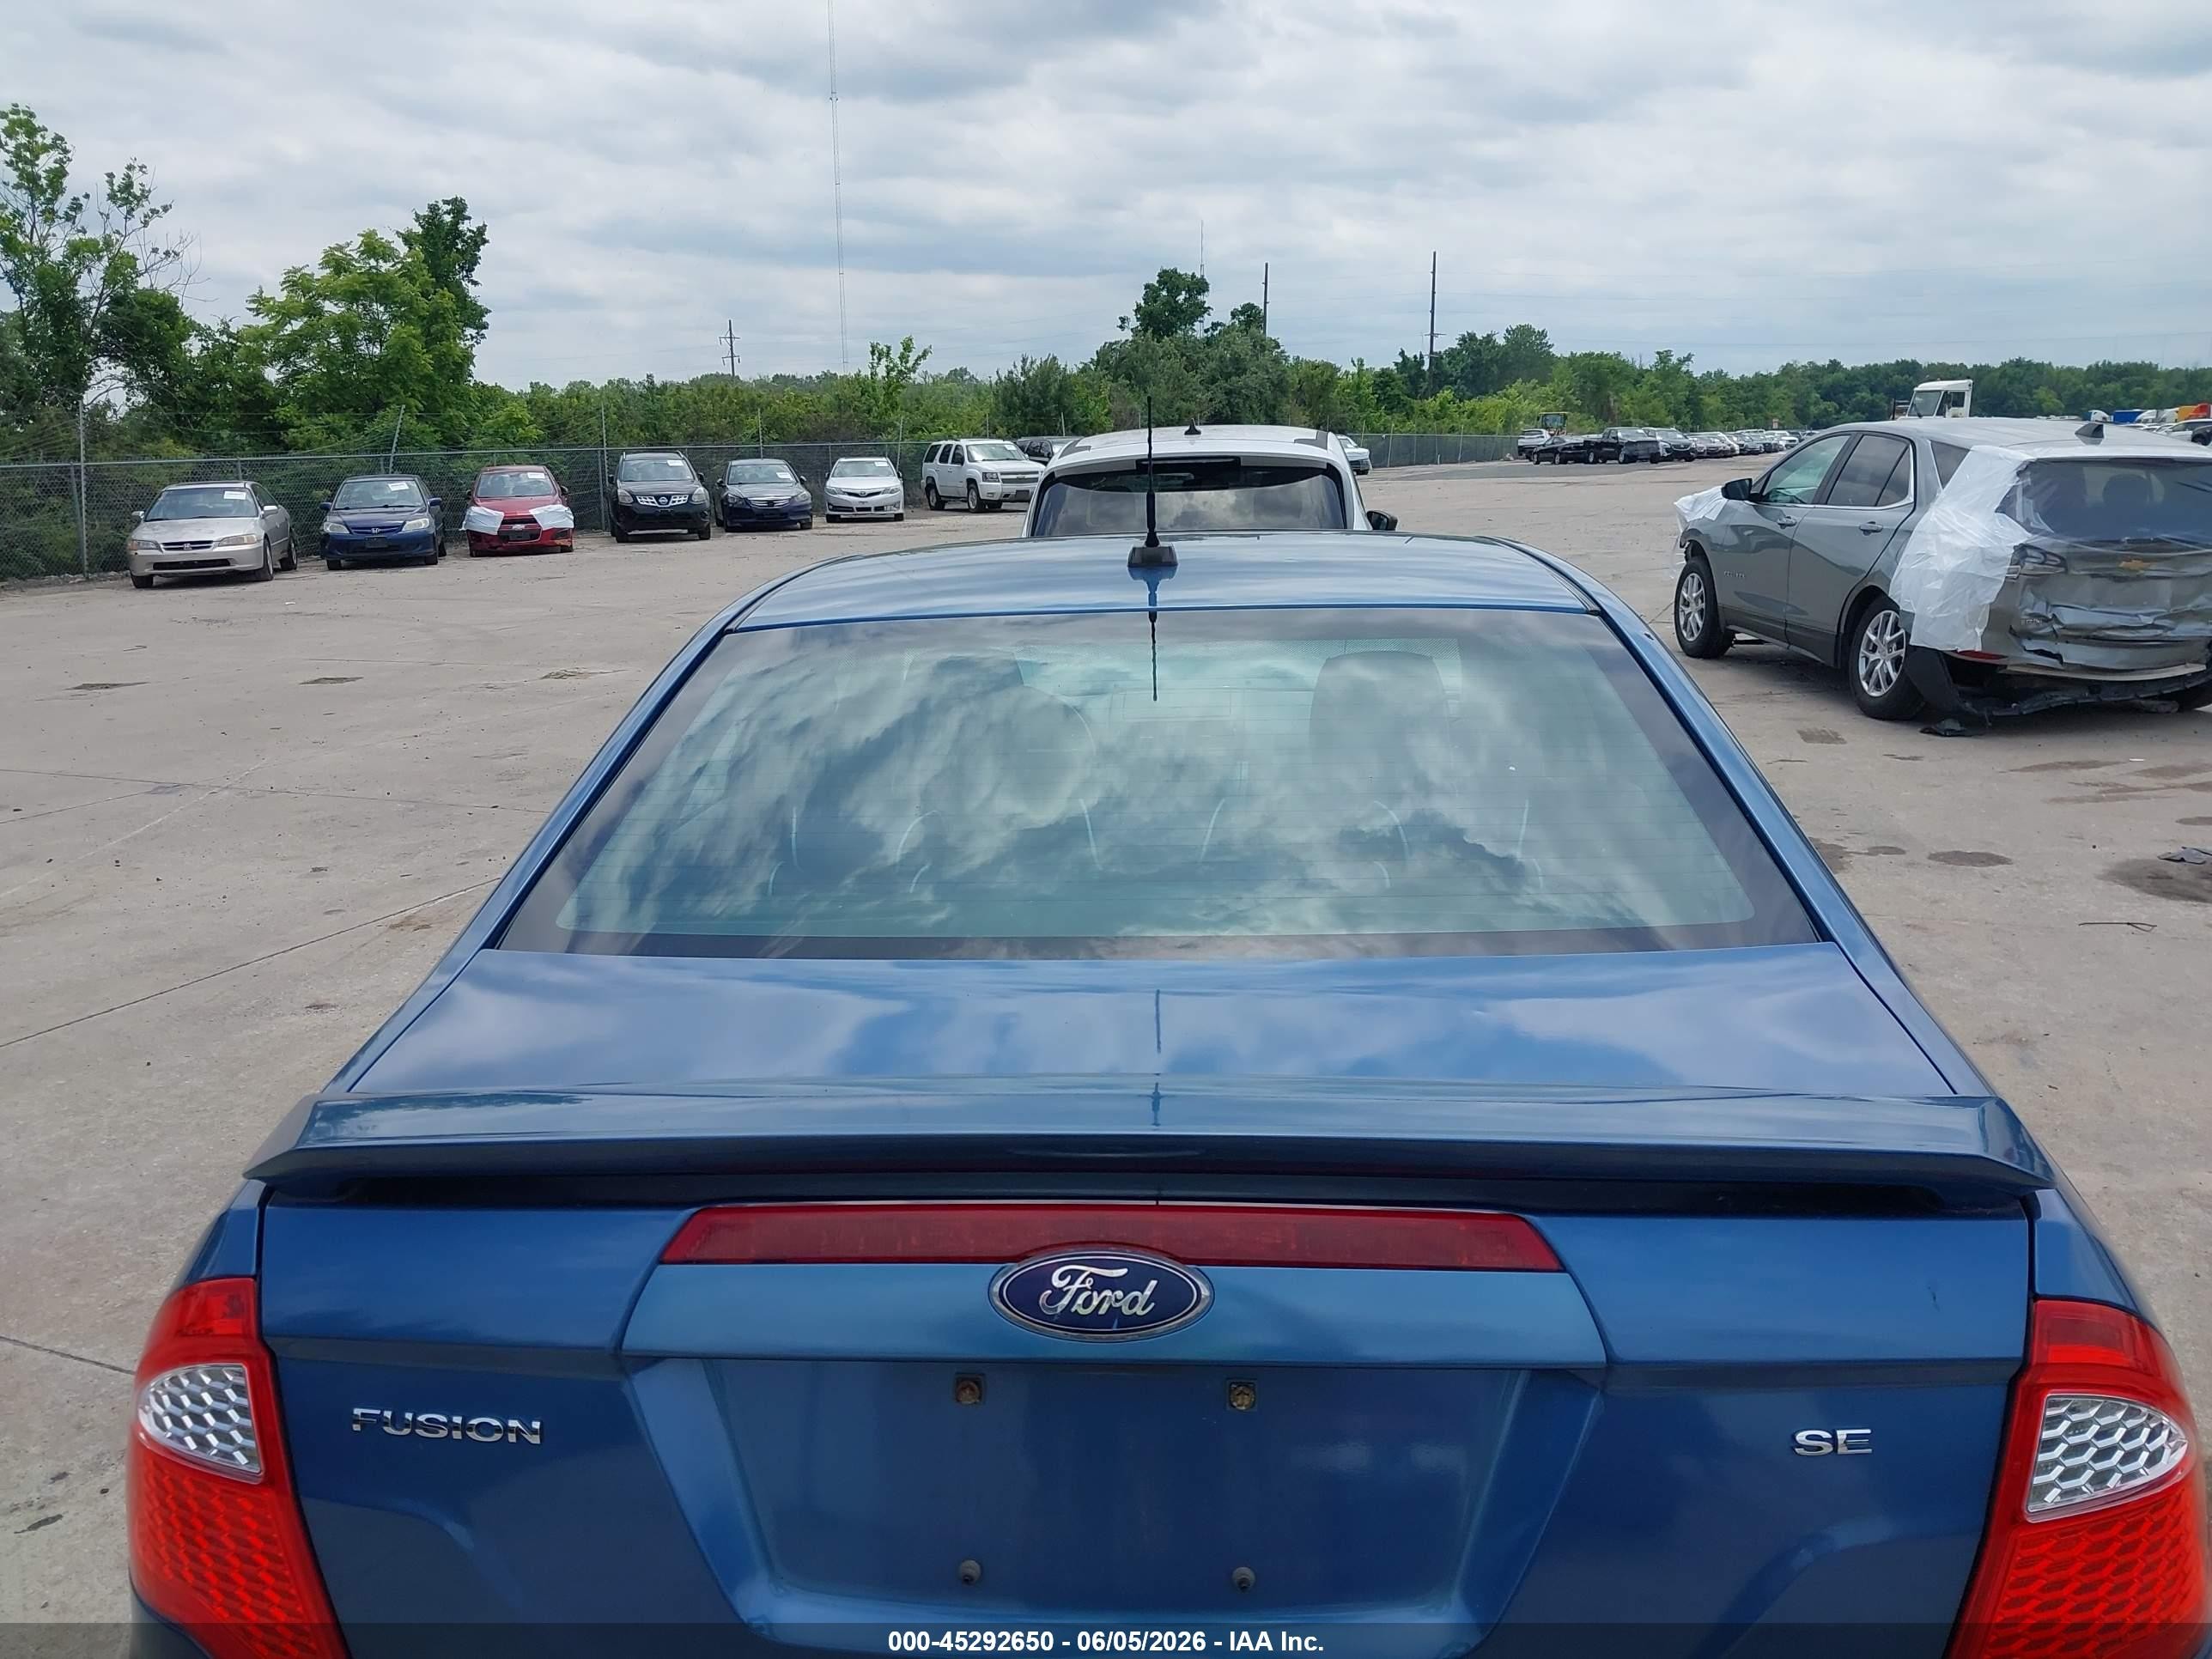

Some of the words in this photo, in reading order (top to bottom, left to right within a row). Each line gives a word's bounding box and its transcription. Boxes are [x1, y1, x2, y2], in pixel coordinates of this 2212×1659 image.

[1039, 1264, 1158, 1316] Ford
[352, 1407, 542, 1445] FUSION
[1794, 1428, 1873, 1456] SE
